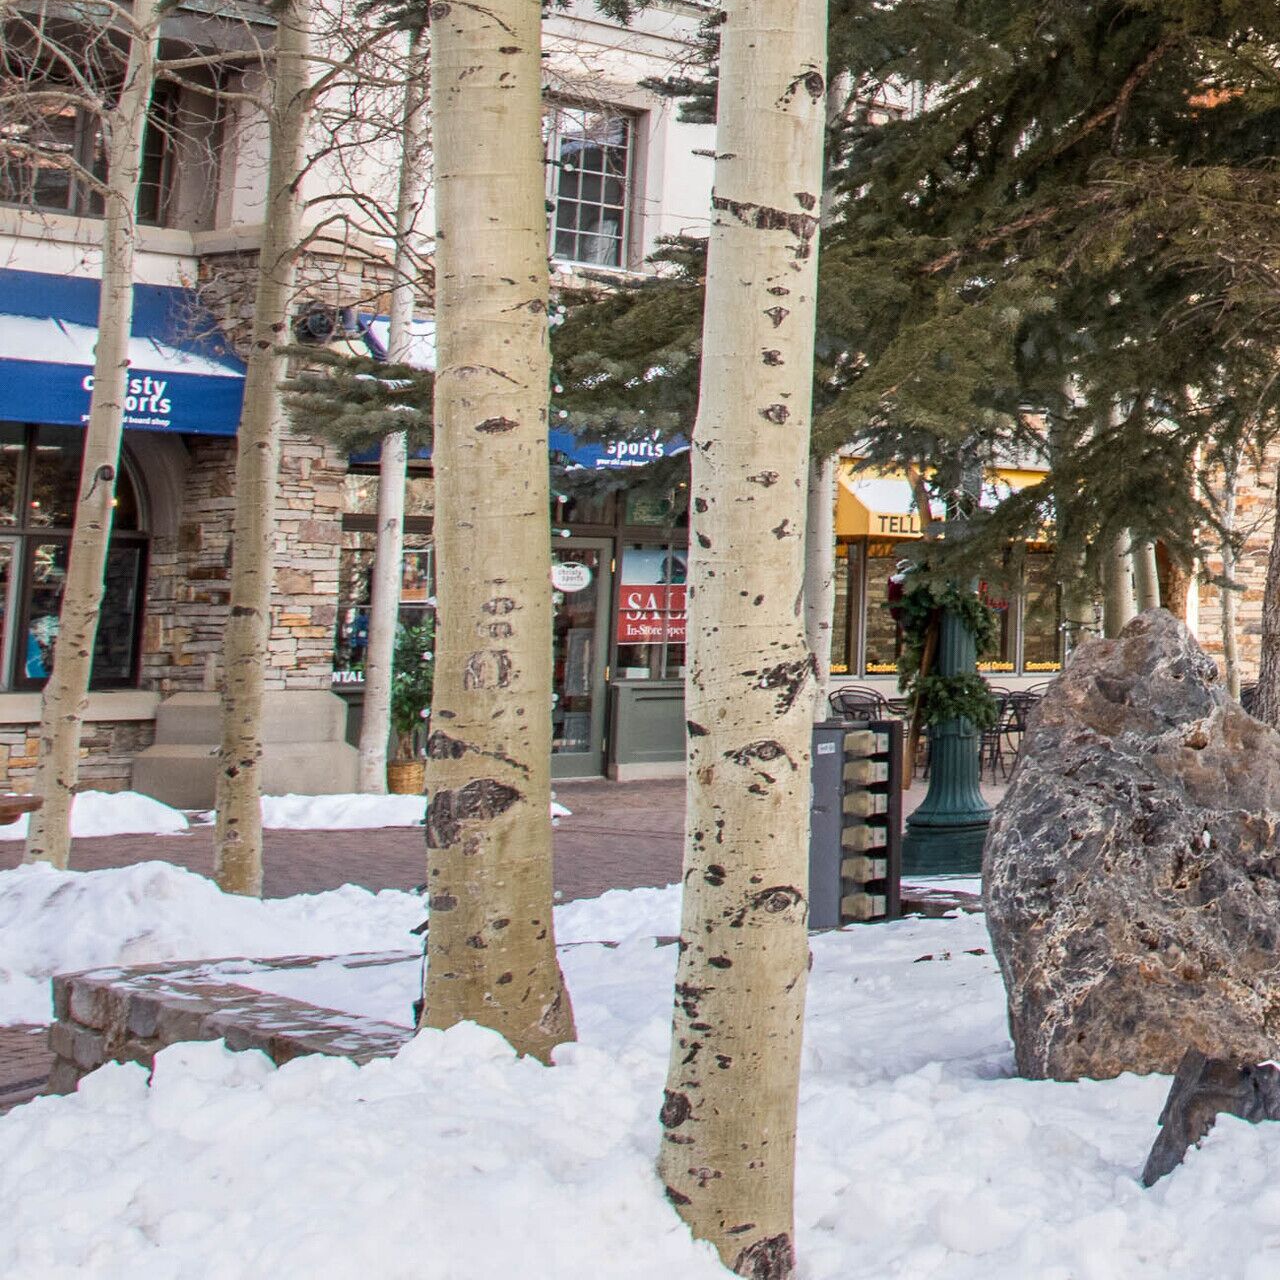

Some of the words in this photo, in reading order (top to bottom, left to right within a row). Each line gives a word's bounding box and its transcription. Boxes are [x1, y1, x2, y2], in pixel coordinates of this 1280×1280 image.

[877, 514, 920, 535] TELL
[626, 591, 688, 621] SAL
[331, 671, 365, 683] NTAL
